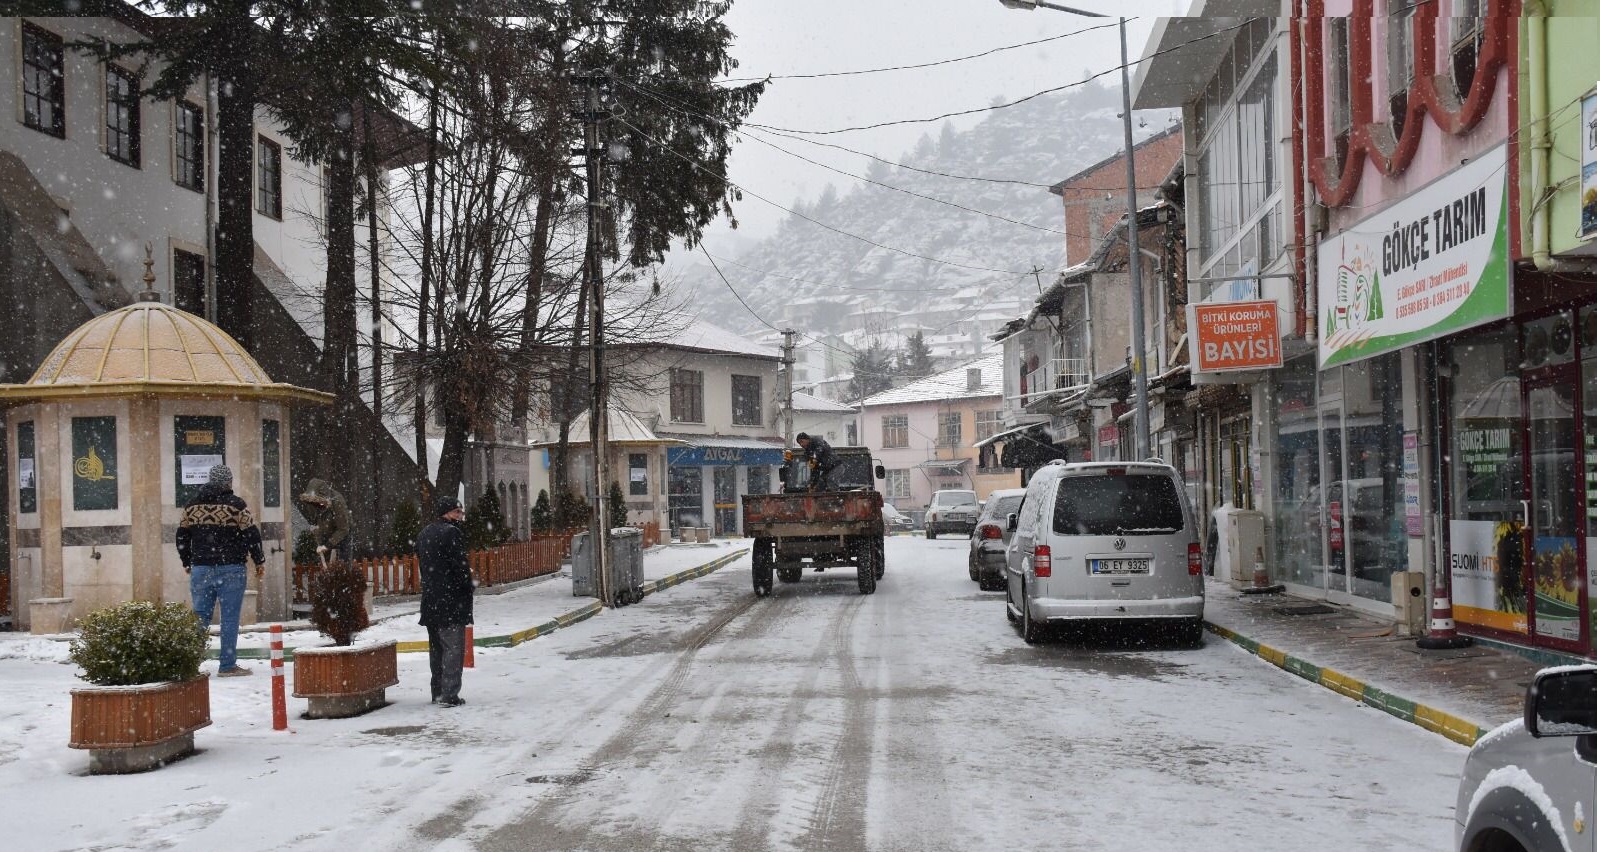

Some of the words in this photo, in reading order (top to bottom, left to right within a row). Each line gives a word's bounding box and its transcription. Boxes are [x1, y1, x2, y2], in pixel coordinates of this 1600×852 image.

[1383, 215, 1429, 277] GÖKÇE
[1434, 187, 1486, 254] TARIM
[1202, 311, 1227, 323] BİTKİ
[1229, 309, 1271, 321] KORUMA
[1213, 321, 1262, 335] ÜRÜNLERİ
[1204, 334, 1274, 362] BAYİSİ
[1485, 428, 1510, 449] TARIM
[704, 447, 743, 461] AYGAZ
[1099, 560, 1109, 570] 06
[1113, 560, 1123, 570] EY
[1127, 560, 1148, 570] 9325
[1452, 552, 1479, 571] SUOMİ
